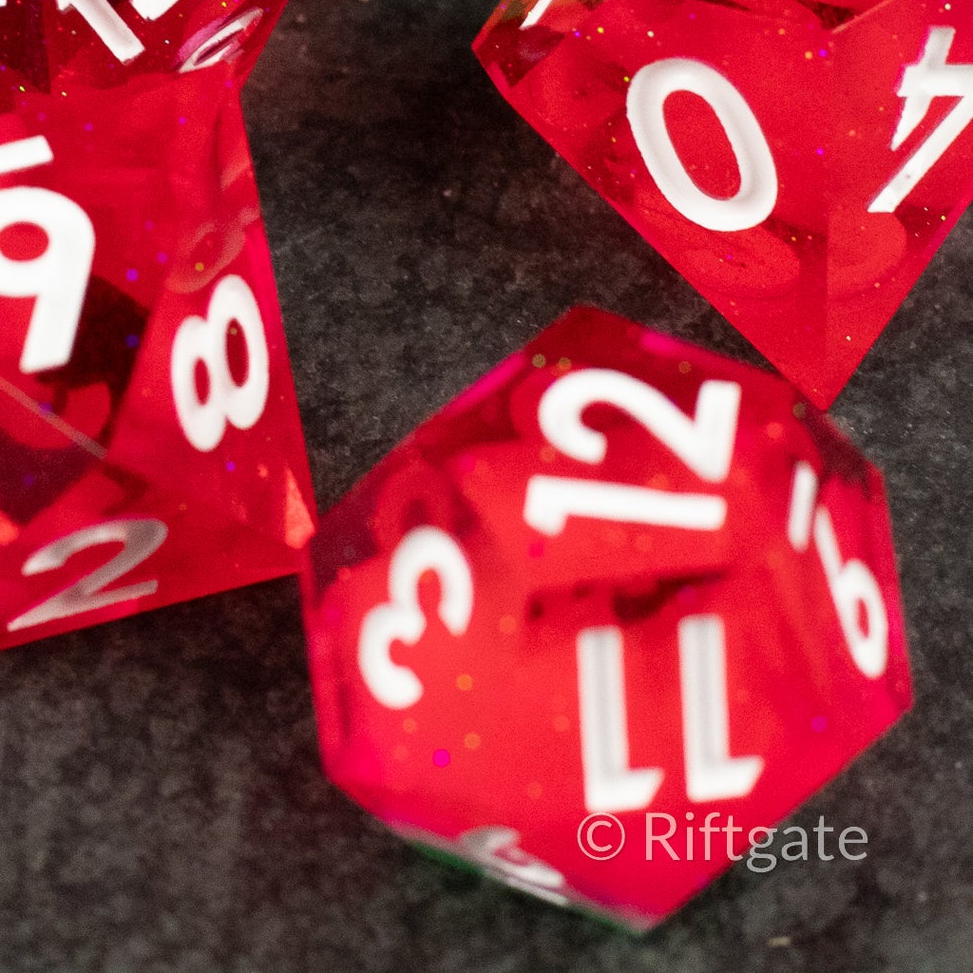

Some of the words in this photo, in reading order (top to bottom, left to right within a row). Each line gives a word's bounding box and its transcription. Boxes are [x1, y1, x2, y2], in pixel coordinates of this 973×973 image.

[627, 57, 778, 232] 0
[867, 27, 973, 213] 4
[171, 274, 269, 452] 8
[523, 368, 741, 536] 12
[7, 518, 168, 632] 2
[358, 526, 474, 710] 3
[576, 614, 765, 814] 11
